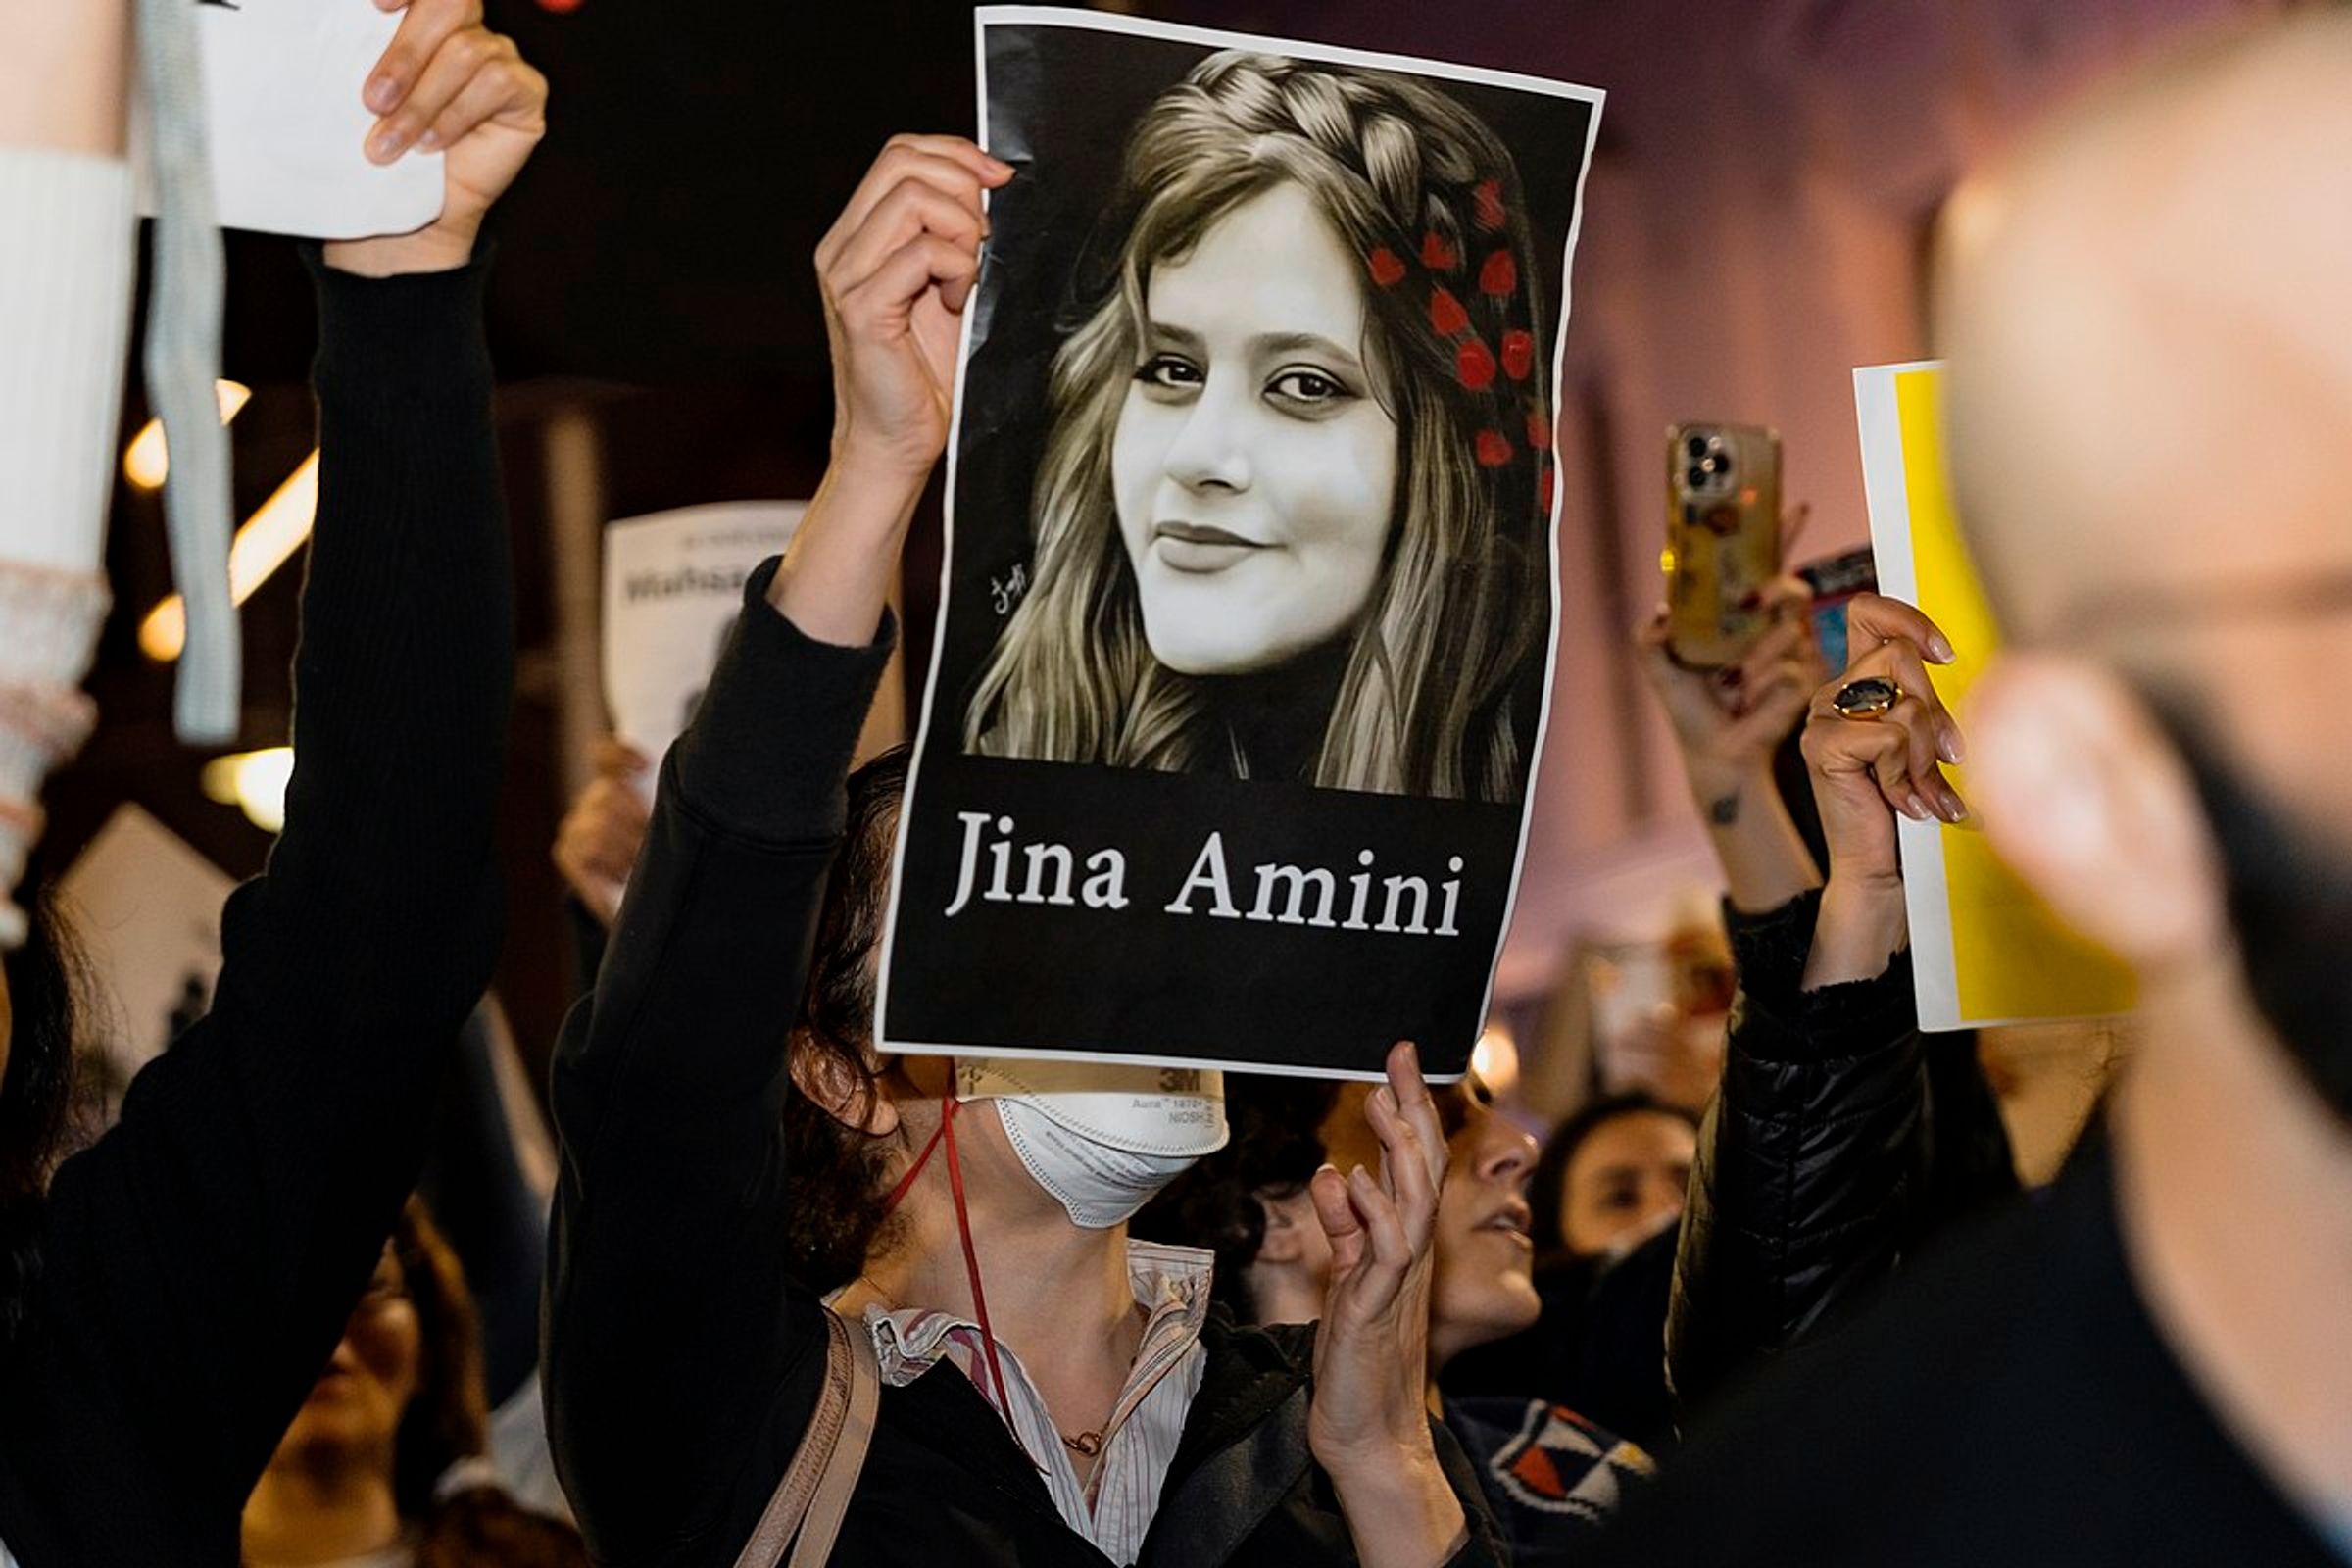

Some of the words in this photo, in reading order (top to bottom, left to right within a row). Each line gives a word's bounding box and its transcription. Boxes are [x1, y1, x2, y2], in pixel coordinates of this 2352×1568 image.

[945, 810, 1129, 916] Jina
[1164, 831, 1464, 937] Amini
[1160, 1067, 1200, 1092] 3M
